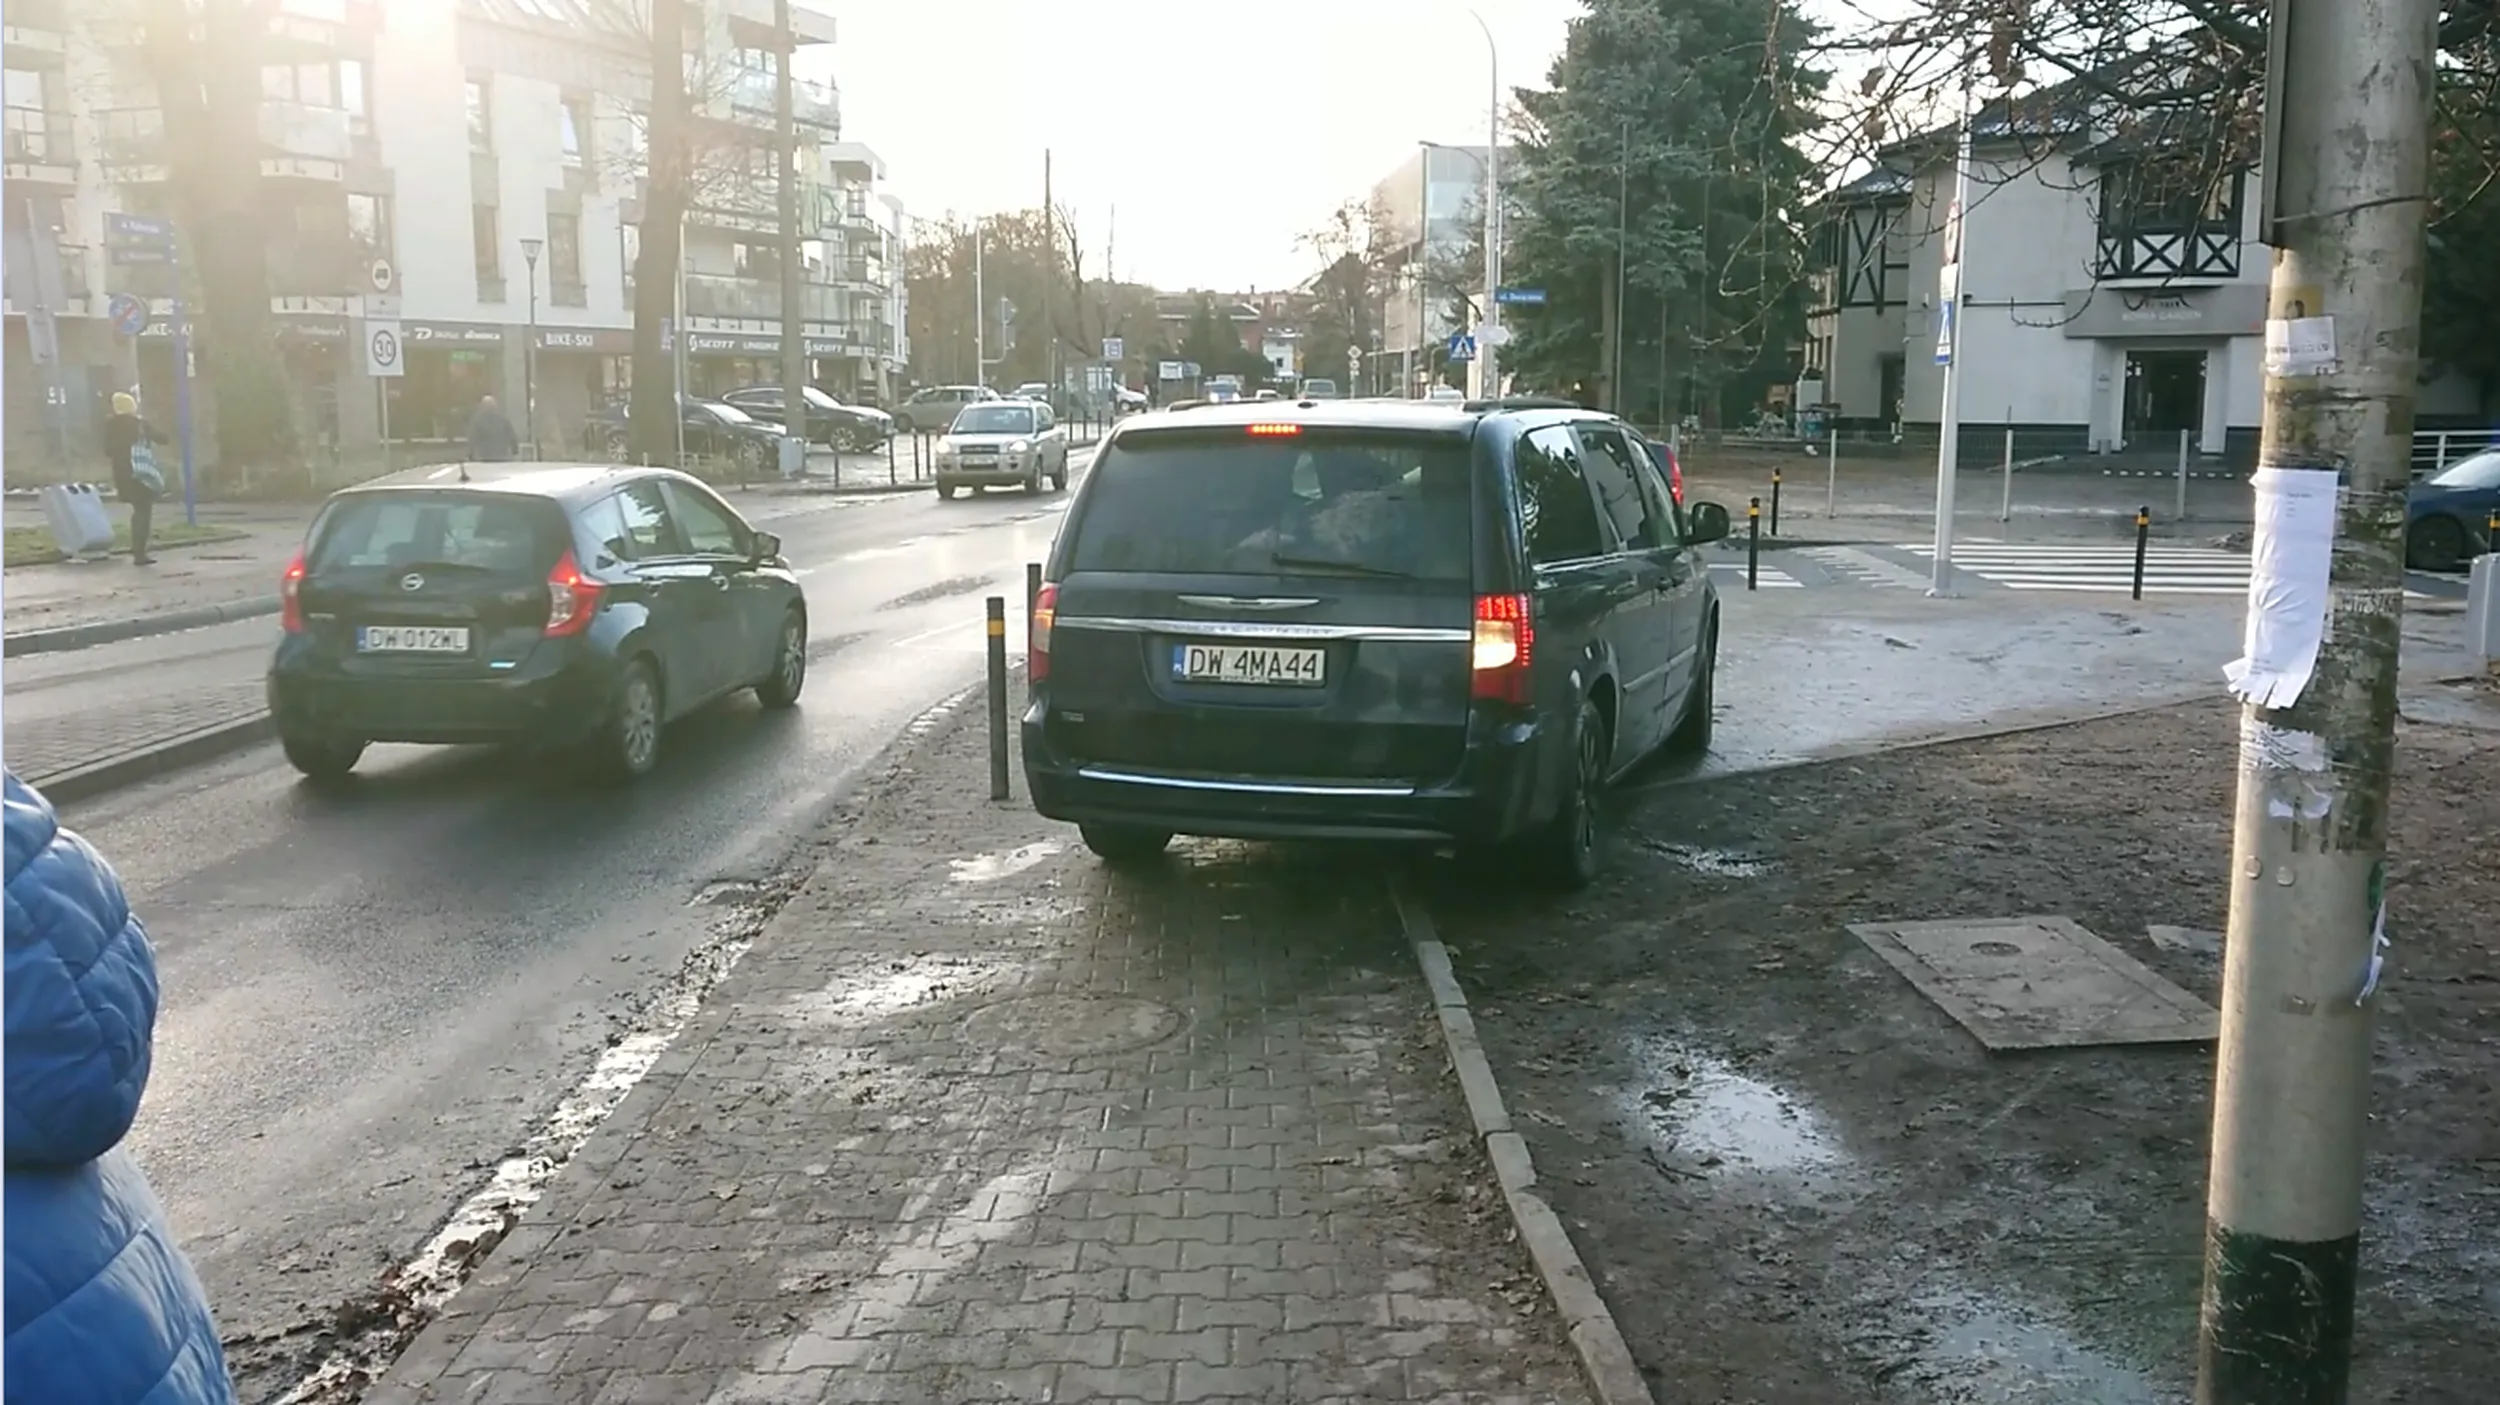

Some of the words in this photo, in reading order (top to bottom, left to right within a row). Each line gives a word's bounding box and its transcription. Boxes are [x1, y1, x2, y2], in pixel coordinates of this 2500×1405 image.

[546, 332, 593, 347] BIKE-SKI
[699, 339, 735, 348] SCOTT
[375, 340, 393, 357] 30
[812, 343, 842, 353] SCOTT
[1190, 648, 1224, 674] DW
[1233, 650, 1318, 678] 4MA44
